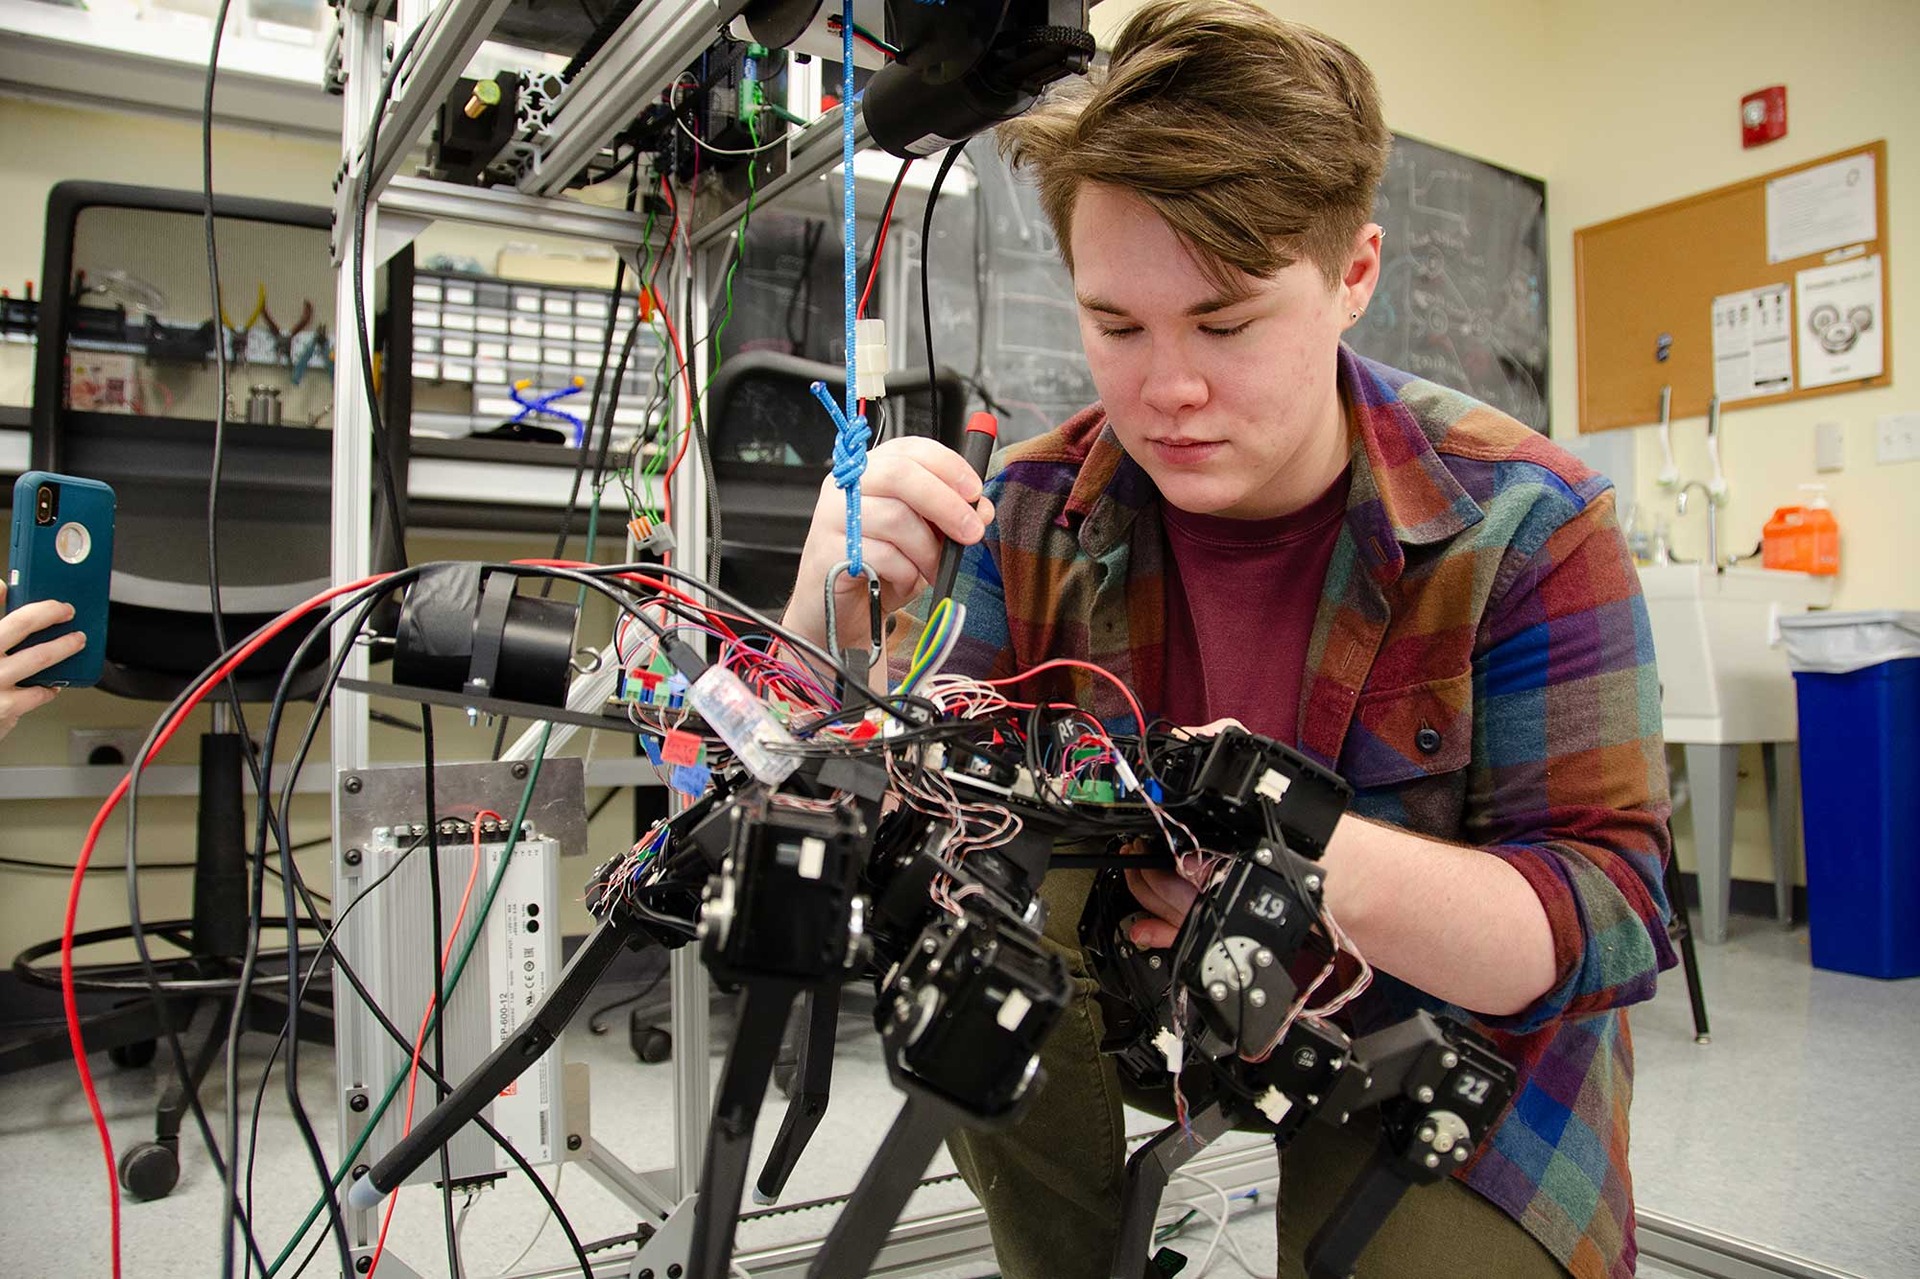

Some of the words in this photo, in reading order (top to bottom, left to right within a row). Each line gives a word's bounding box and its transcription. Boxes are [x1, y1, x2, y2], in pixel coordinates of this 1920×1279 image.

[1057, 718, 1076, 744] RF
[1254, 893, 1285, 919] 19
[498, 993, 509, 1042] EP-600-12
